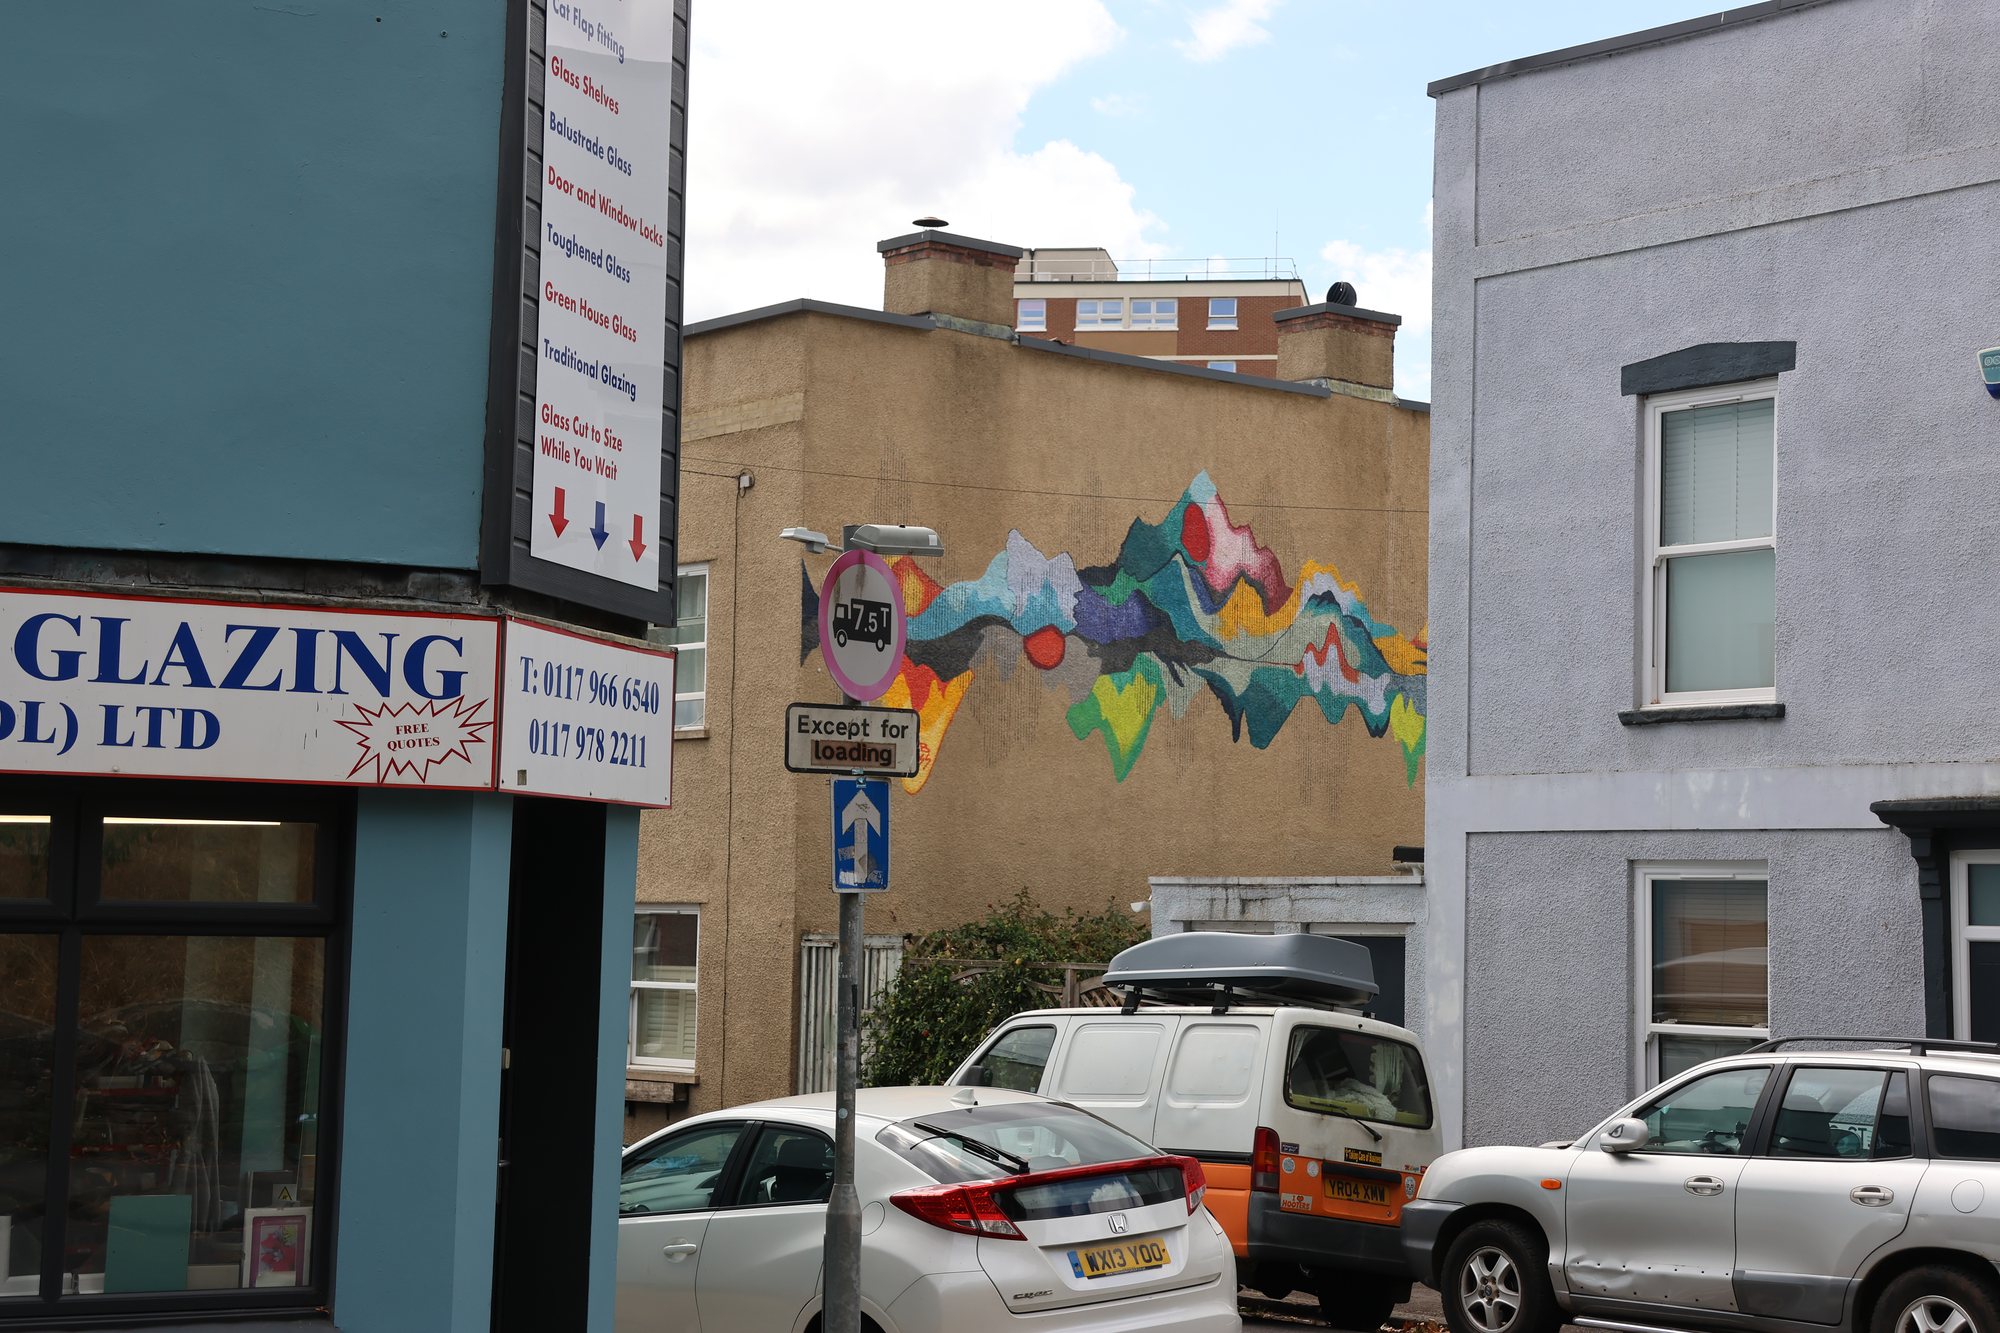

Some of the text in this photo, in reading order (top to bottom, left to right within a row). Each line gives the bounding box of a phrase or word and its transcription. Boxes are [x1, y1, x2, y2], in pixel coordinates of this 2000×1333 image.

[552, 0, 625, 64] Cat Flap fitting
[551, 55, 619, 115] Glass Shelves
[550, 111, 632, 176] Balustrade Glass
[548, 165, 663, 247] Door and Window Locks
[547, 222, 631, 284] Toughened Glass
[545, 281, 637, 343] Green House Glass
[544, 338, 636, 402] Traditional Glazing
[541, 403, 623, 452] Glass Cut to Size
[541, 435, 617, 481] While You Wait
[14, 612, 469, 700] GLAZING
[520, 656, 660, 715] T: 0117 966 6540
[97, 703, 221, 750] LTD
[387, 737, 441, 752] QUOTES
[395, 723, 430, 735] FREE
[529, 718, 647, 769] 0117 978 2211
[797, 714, 909, 741] Except for
[814, 740, 892, 767] loading
[1282, 1200, 1311, 1210] HOOTERS
[1328, 1179, 1360, 1198] YR04
[1085, 1243, 1163, 1272] WX13 YOO
